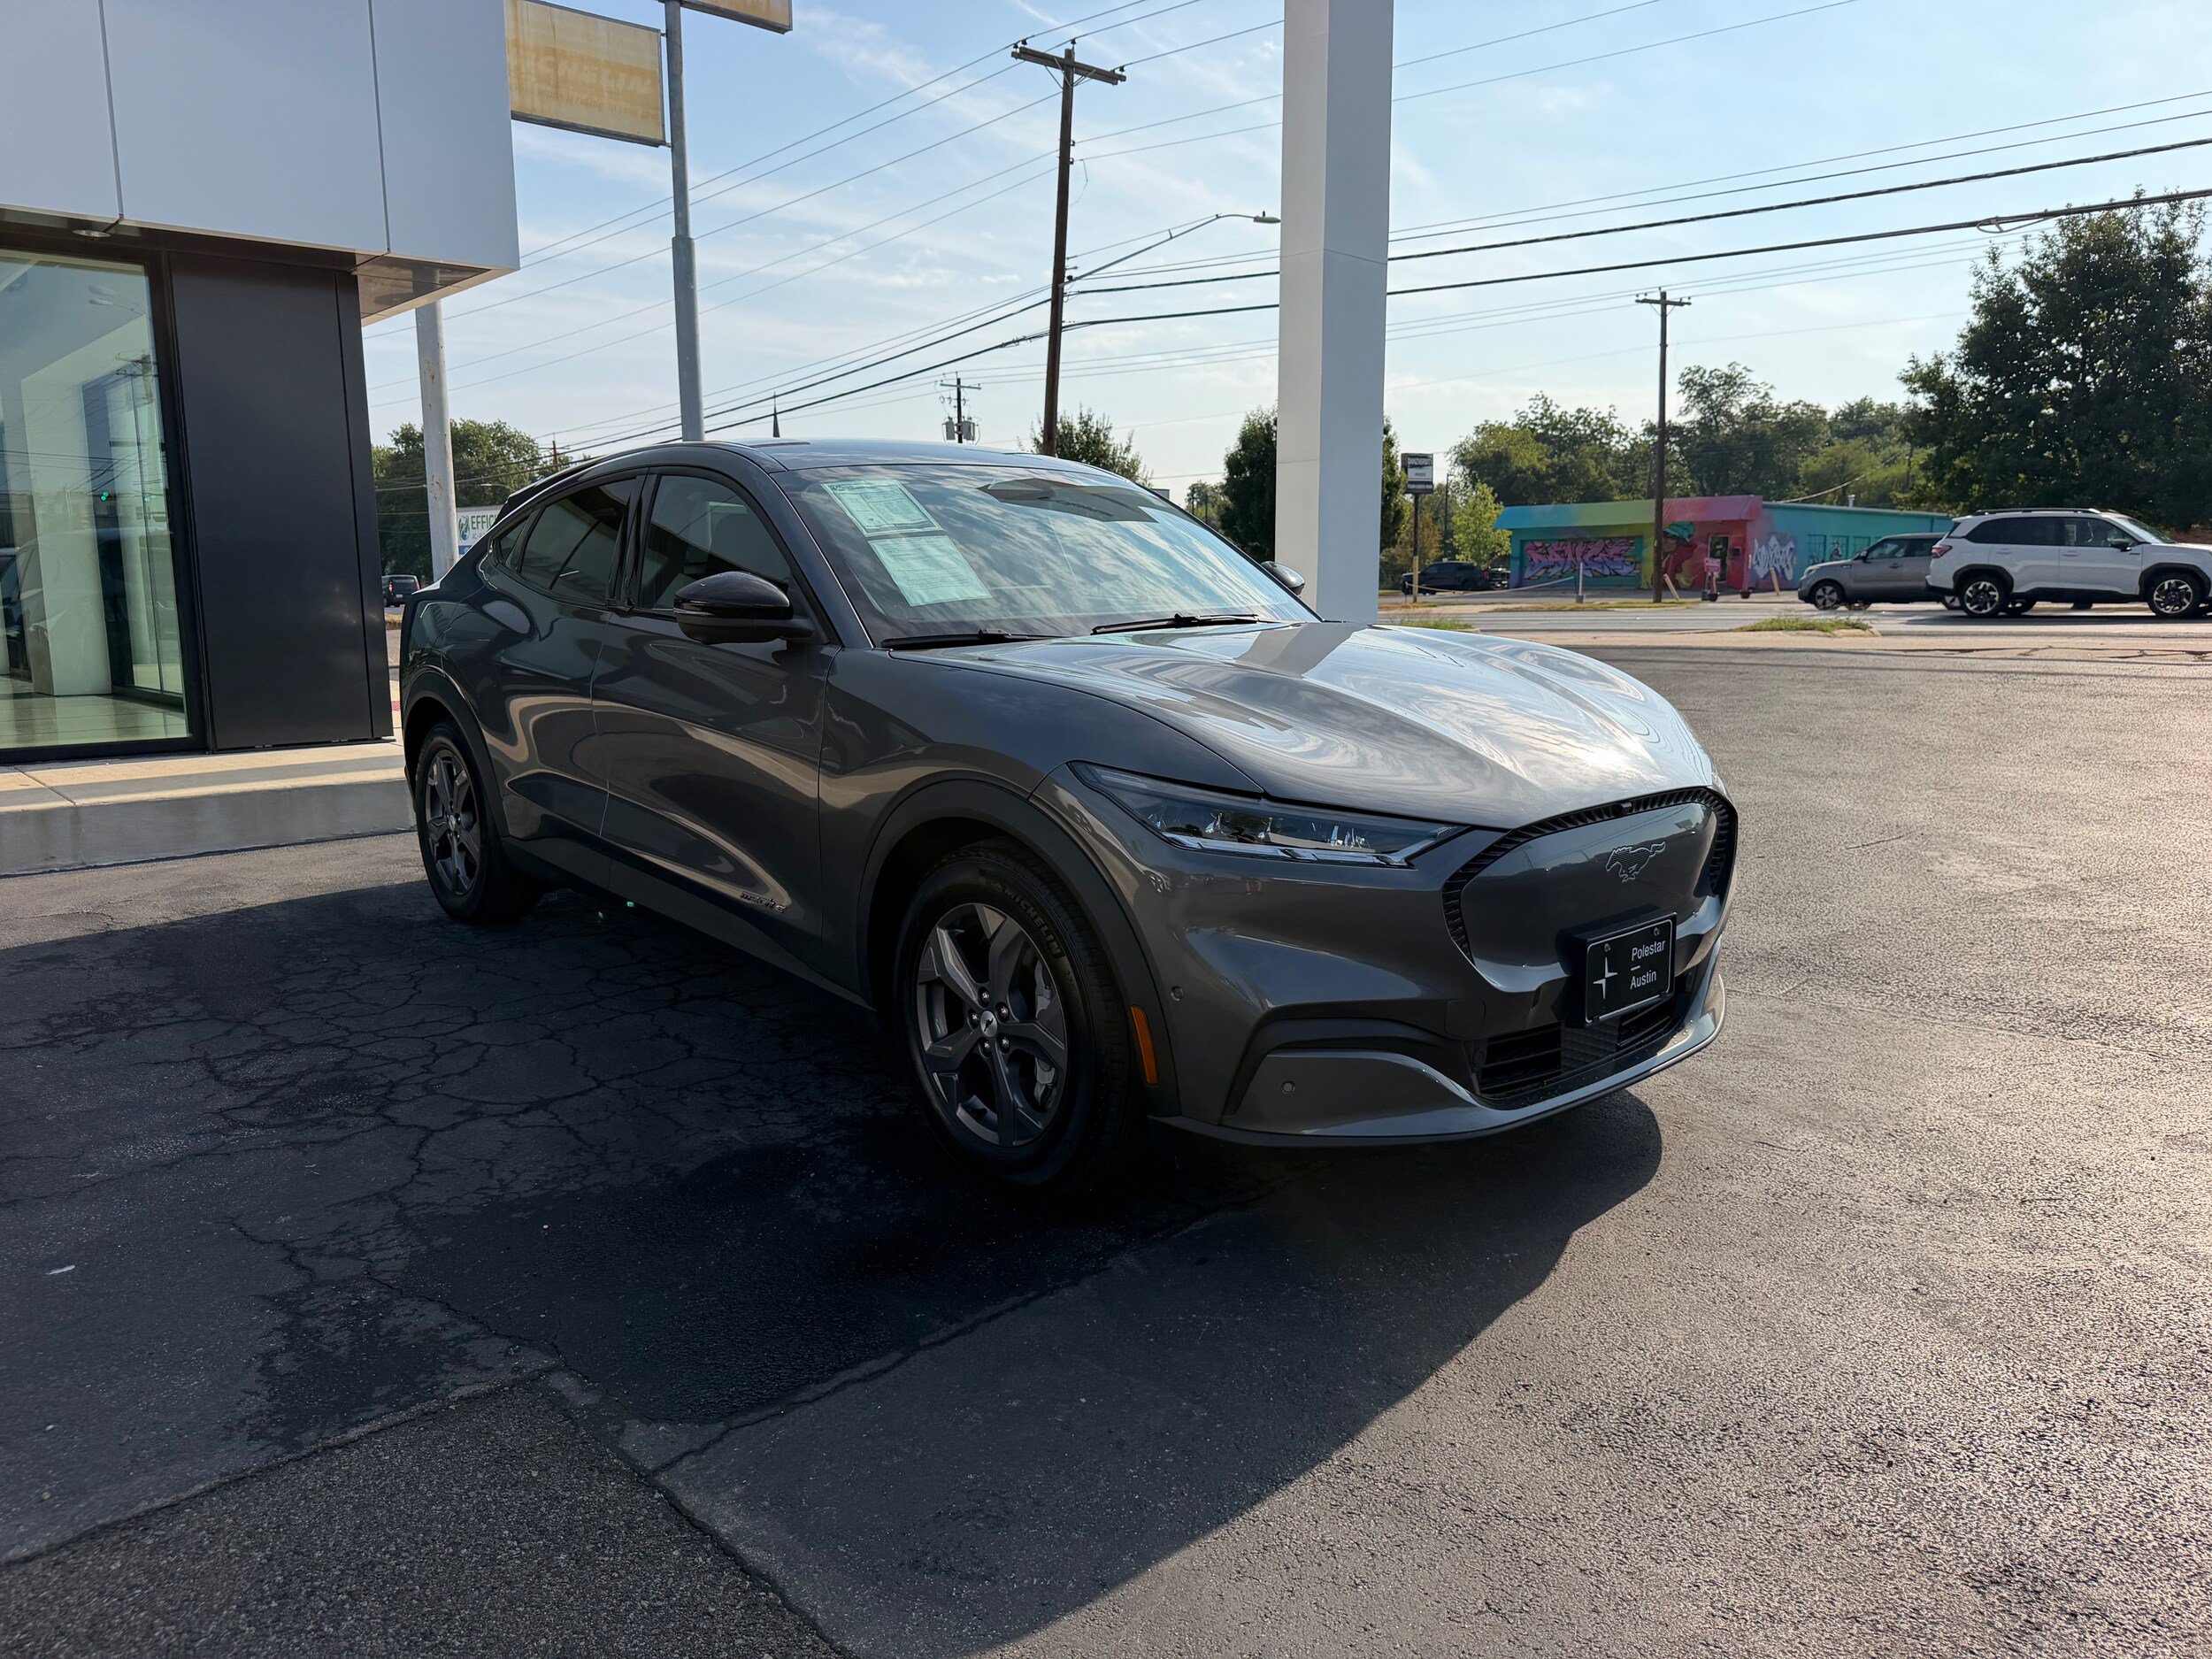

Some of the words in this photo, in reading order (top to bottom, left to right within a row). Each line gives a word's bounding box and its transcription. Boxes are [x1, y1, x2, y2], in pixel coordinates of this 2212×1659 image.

[1003, 887, 1061, 955] MICHELIN
[1631, 940, 1666, 962] Polestar
[1630, 970, 1657, 990] Austin
